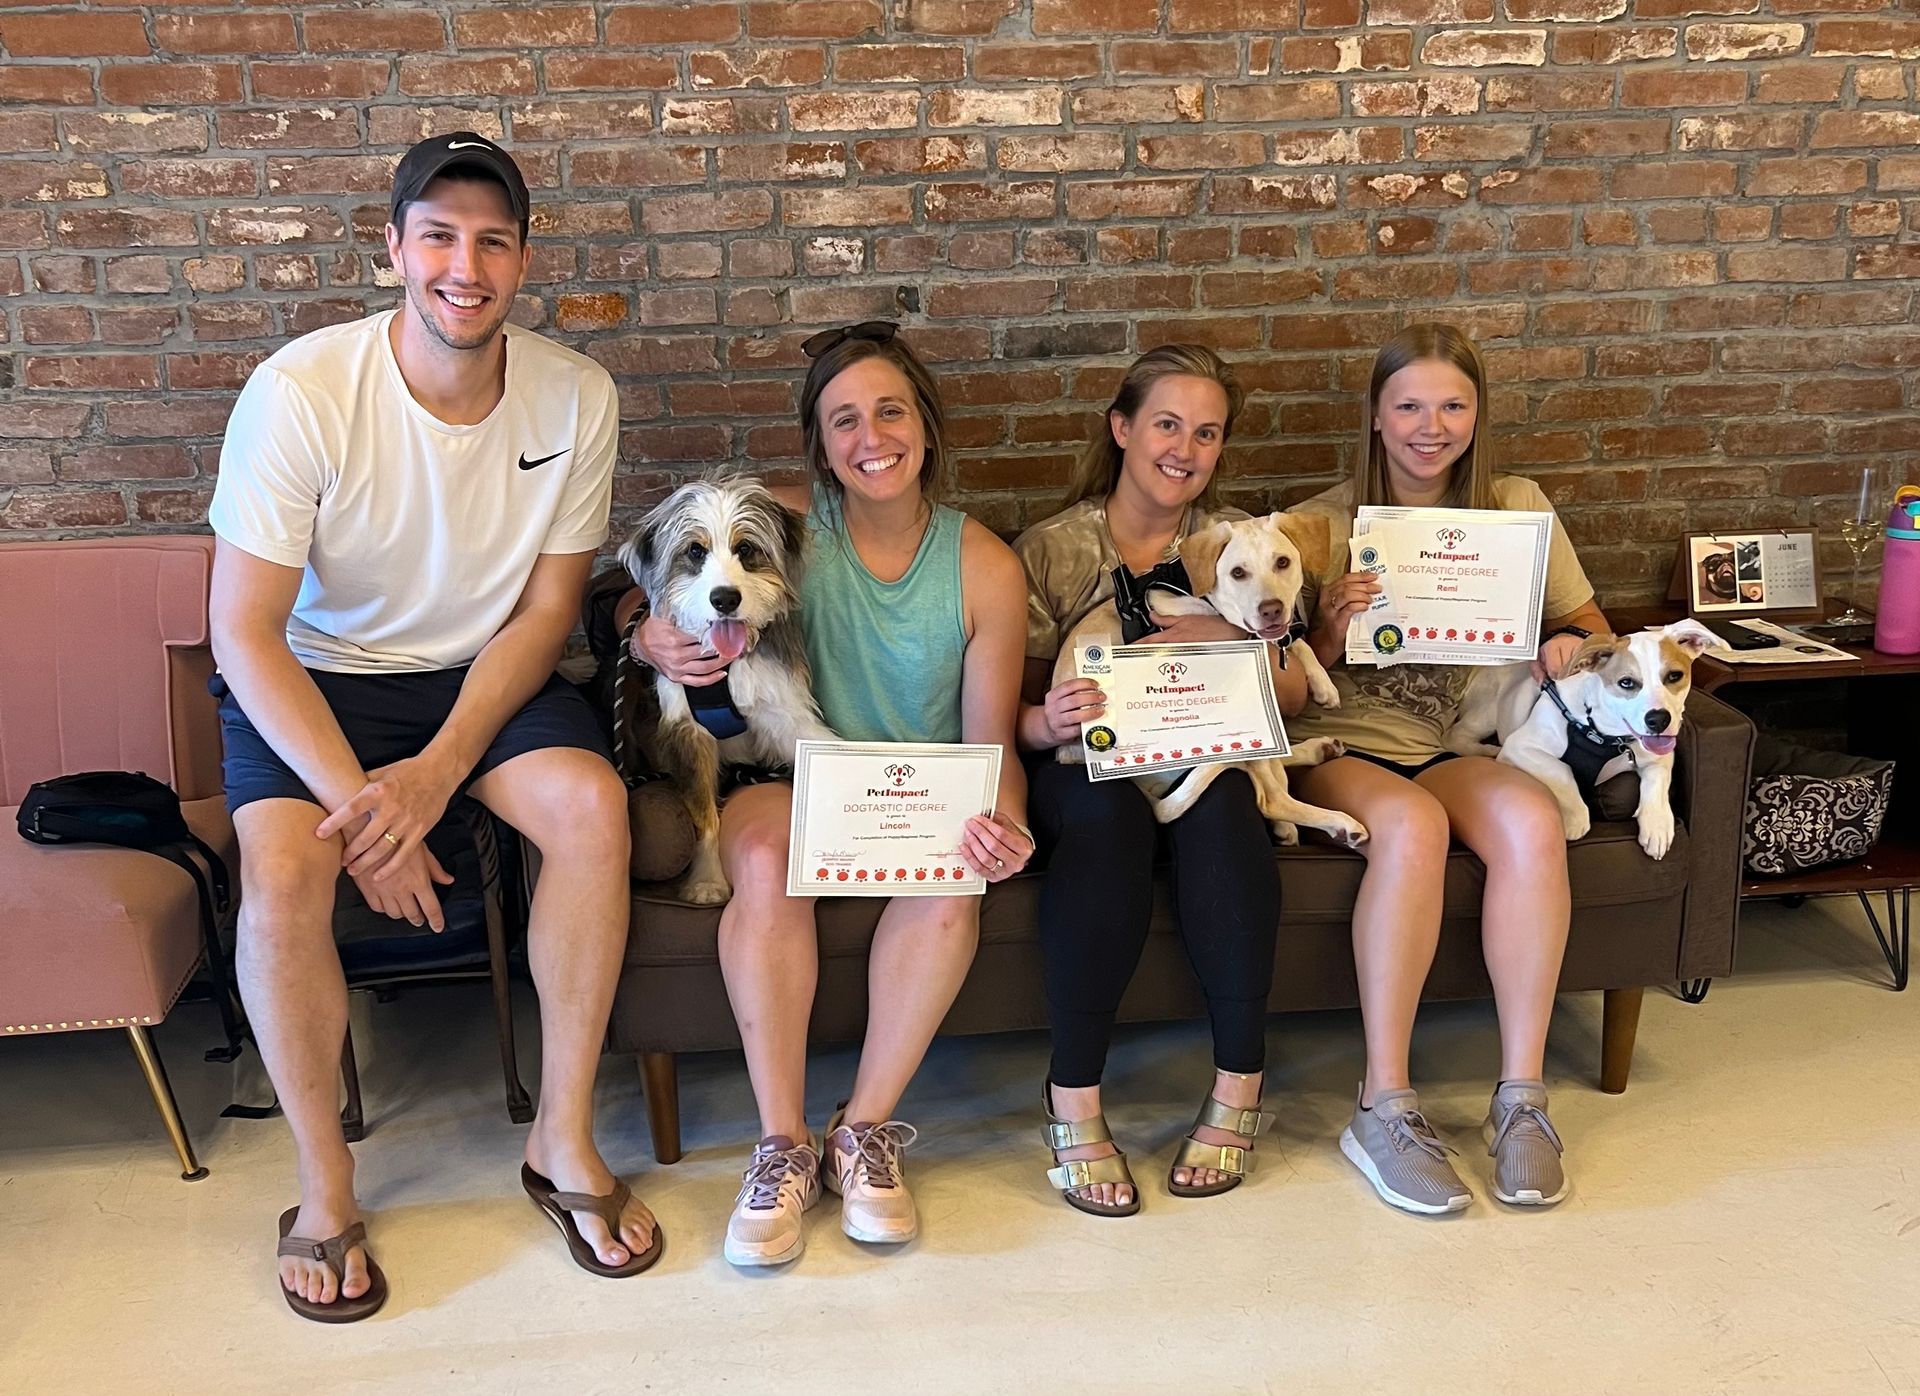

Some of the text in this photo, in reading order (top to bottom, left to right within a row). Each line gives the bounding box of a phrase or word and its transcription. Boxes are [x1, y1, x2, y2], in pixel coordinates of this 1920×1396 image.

[1778, 543, 1798, 551] JUNE
[1419, 550, 1480, 562] PetImpact!
[1397, 564, 1499, 577] DOGTASTIC DEGREE
[1436, 584, 1458, 592] Remi
[1145, 683, 1206, 695] PetImpact!
[1126, 695, 1228, 710] DOGTASTIC DEGREE
[1161, 713, 1200, 723] Magnolia
[867, 788, 929, 798] PetImpact!
[843, 803, 948, 813] DOGTASTIC DEGREE
[879, 822, 911, 830] Lincoln
